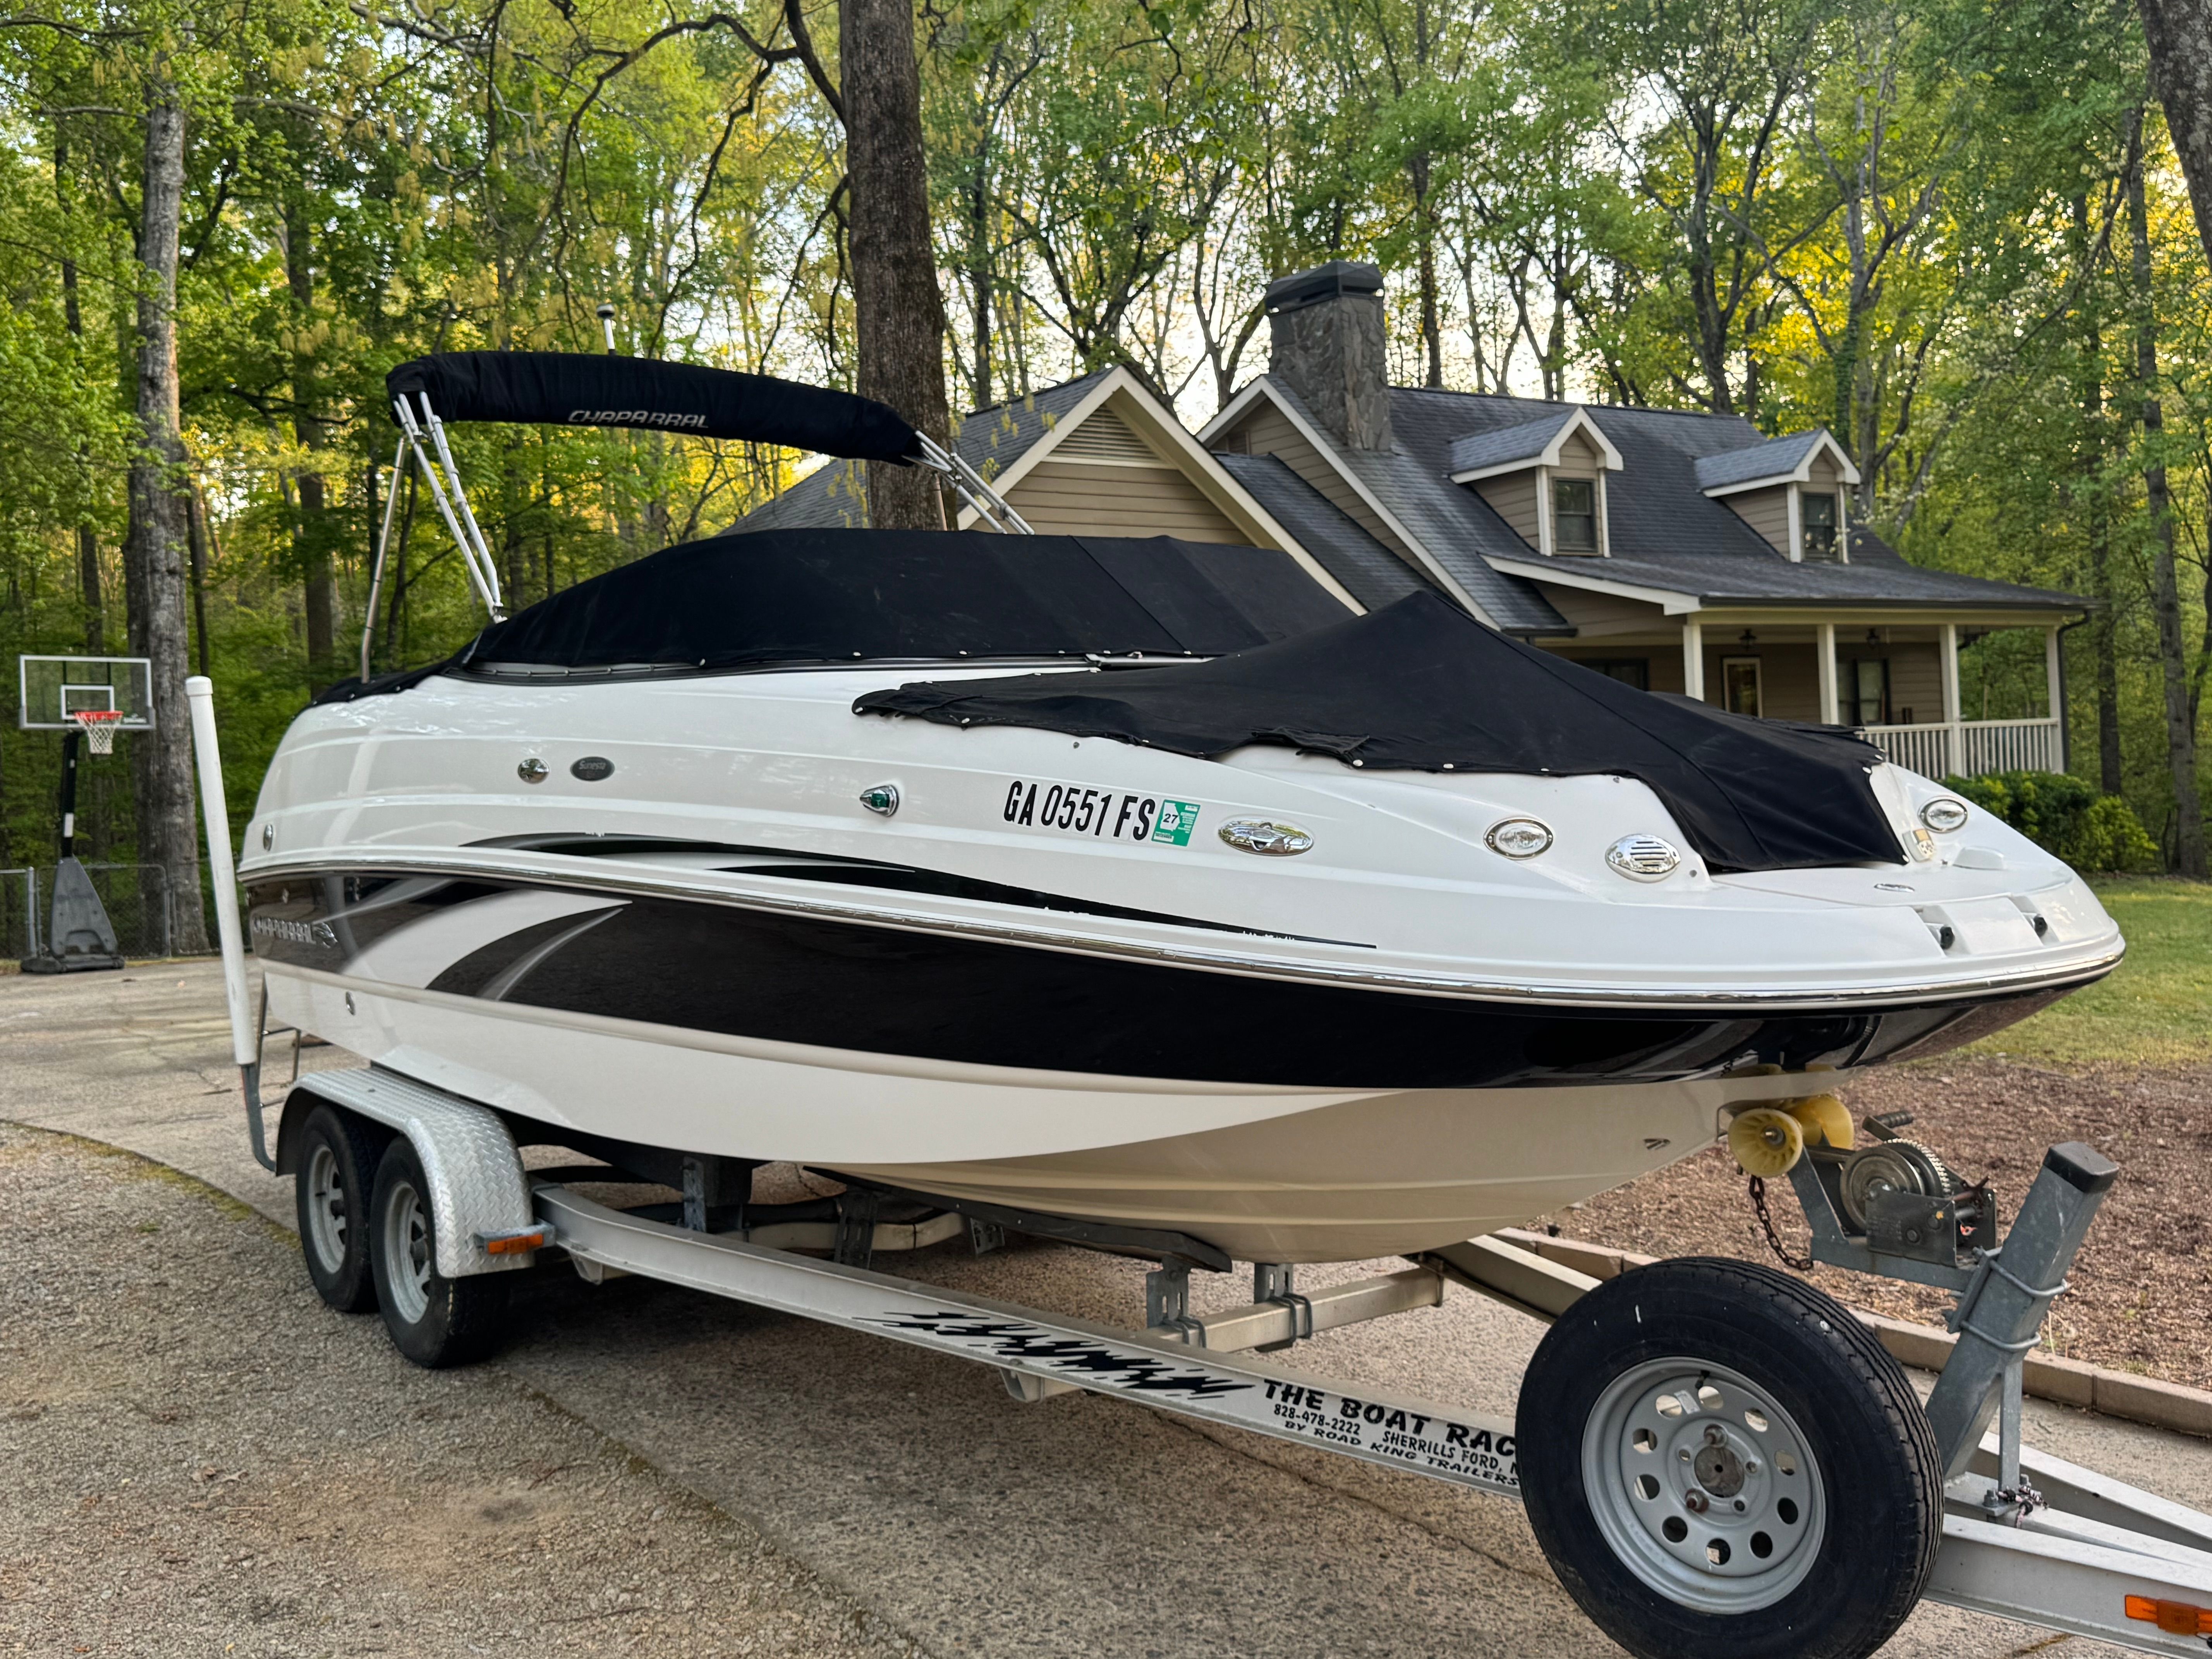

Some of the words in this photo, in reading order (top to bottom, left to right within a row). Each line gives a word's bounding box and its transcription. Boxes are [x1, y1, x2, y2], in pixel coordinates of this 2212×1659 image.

[568, 410, 709, 428] CHAPARRAL
[1004, 781, 1037, 826] GA
[1041, 785, 1112, 836] 0551
[1113, 795, 1155, 841] FS
[1163, 813, 1178, 824] 27
[1264, 1379, 1324, 1410] THE
[1340, 1398, 1431, 1436] BOAT
[1446, 1422, 1516, 1456] RAC
[1274, 1403, 1360, 1435] 828-478-2222
[1382, 1431, 1455, 1458] SHERRILLS
[1462, 1450, 1503, 1473] FORD,
[1285, 1420, 1306, 1431] BY
[1314, 1428, 1361, 1445] ROAD
[1370, 1443, 1417, 1460] KING
[1427, 1456, 1519, 1485] TRAILERS
